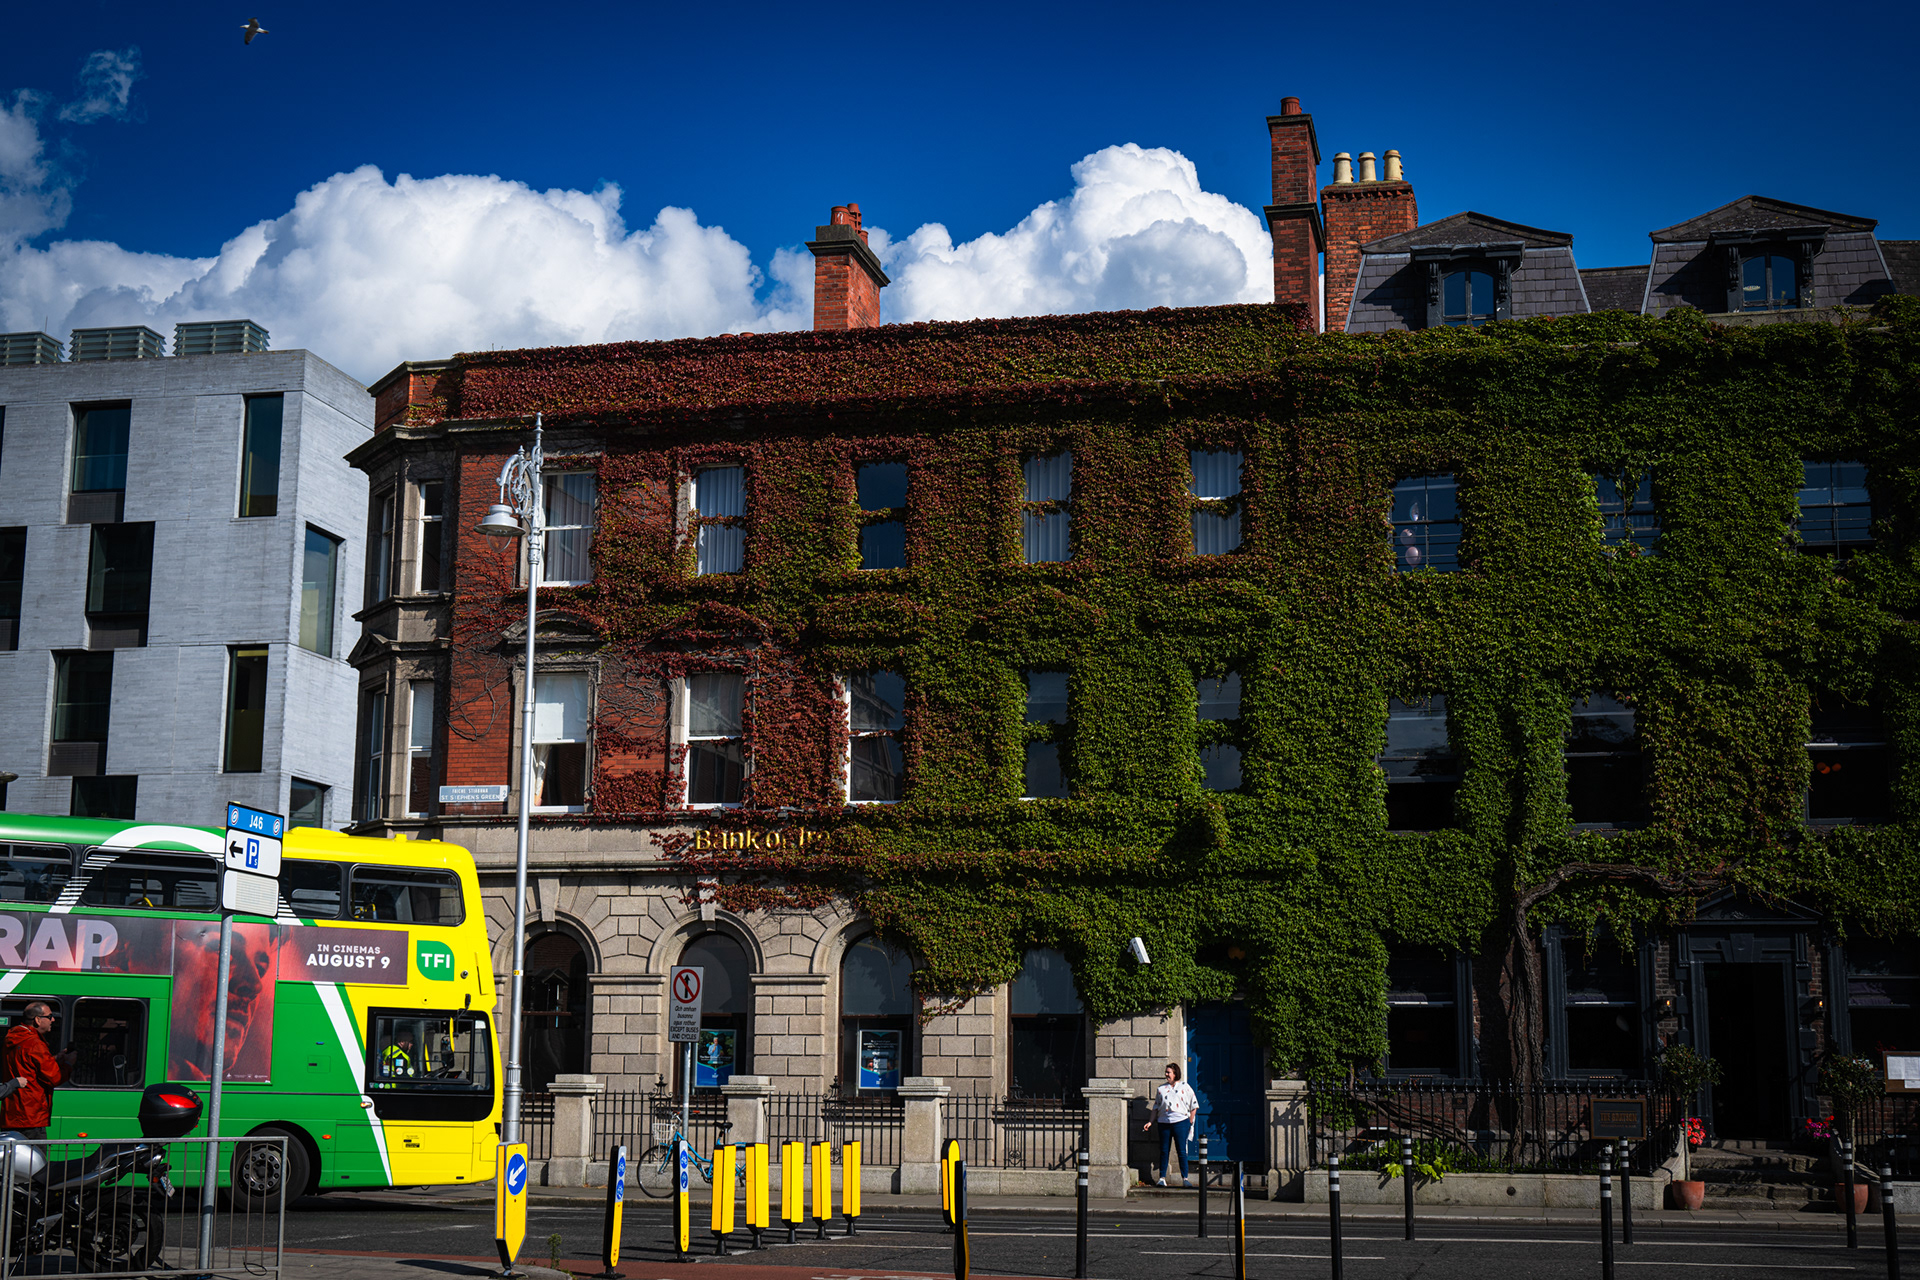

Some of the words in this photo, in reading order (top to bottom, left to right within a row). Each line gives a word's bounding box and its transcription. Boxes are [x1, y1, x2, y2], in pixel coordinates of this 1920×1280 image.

[249, 814, 263, 830] J46
[695, 829, 760, 850] Bank
[248, 841, 258, 865] P
[0, 914, 119, 970] RAP
[317, 943, 330, 952] IN
[333, 944, 381, 955] CINEMAS
[306, 953, 375, 969] AUGUST
[380, 956, 391, 969] 9
[421, 953, 450, 968] TFI
